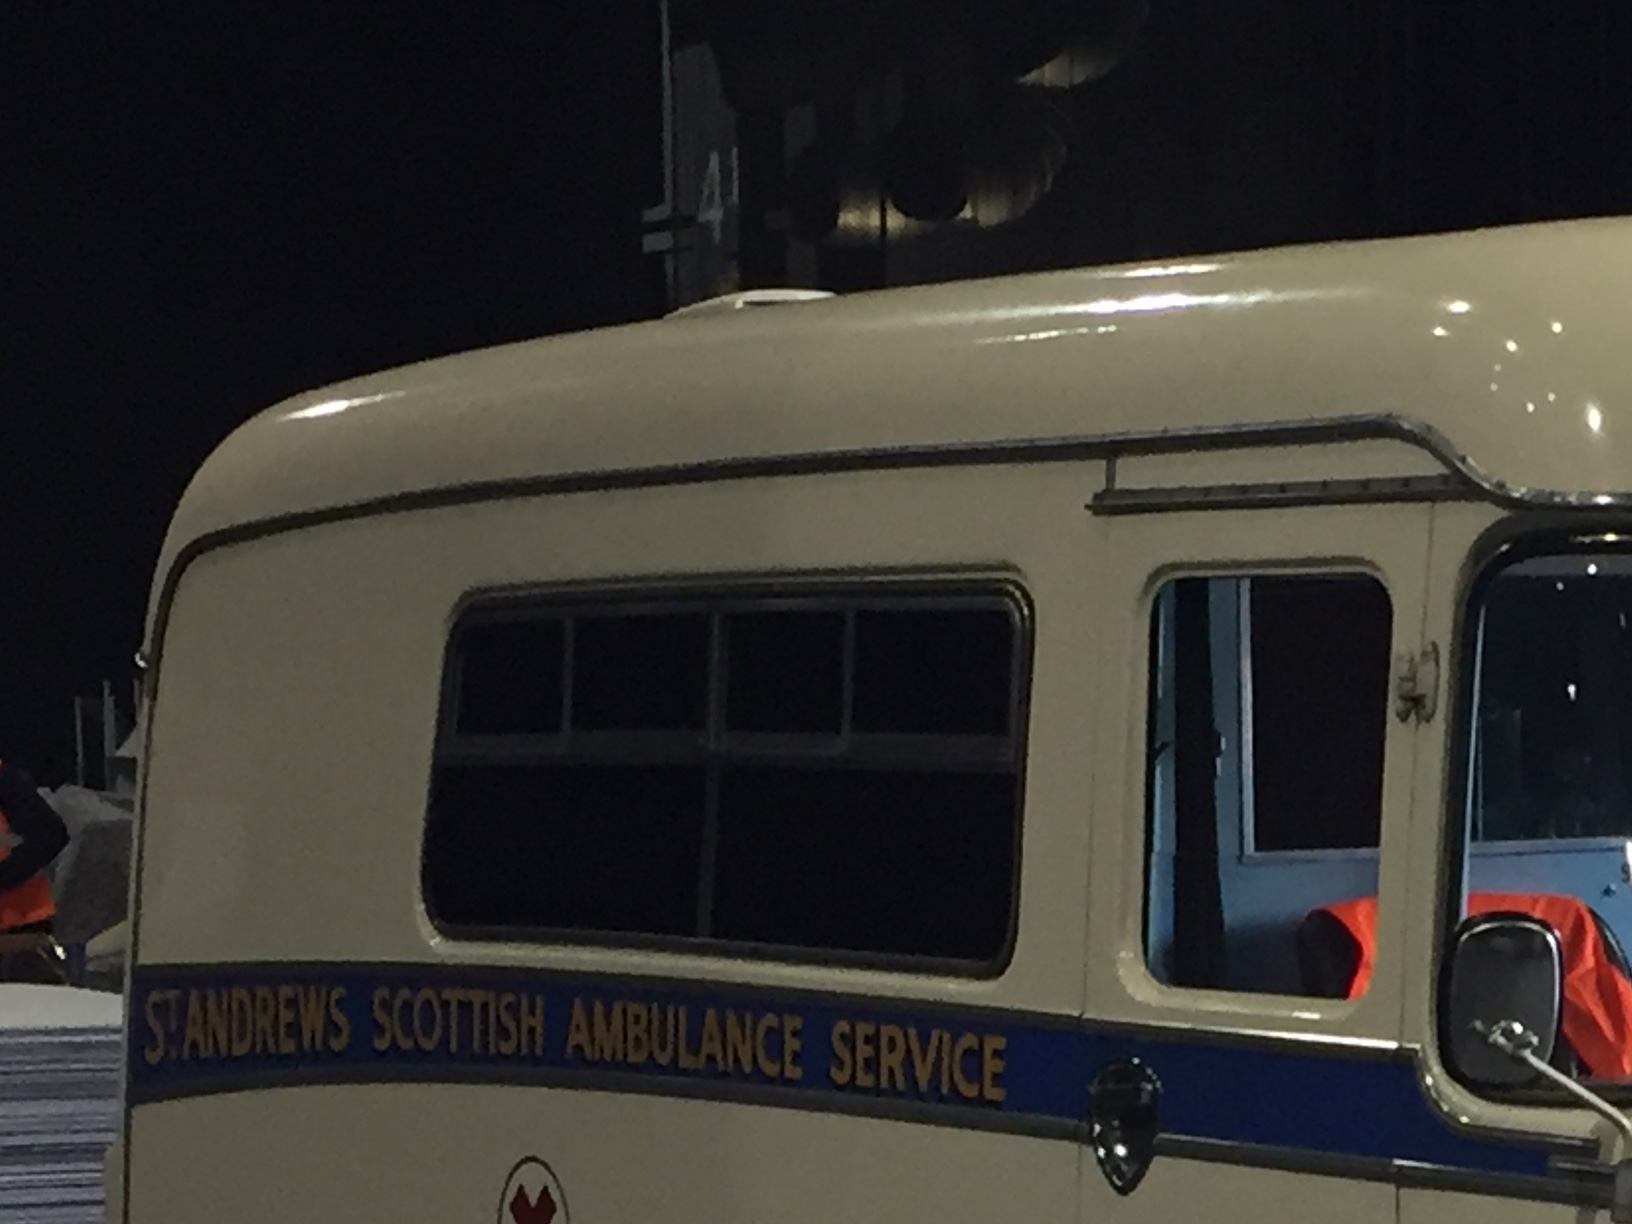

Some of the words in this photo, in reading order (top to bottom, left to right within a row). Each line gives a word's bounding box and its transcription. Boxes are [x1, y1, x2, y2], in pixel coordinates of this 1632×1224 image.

[182, 984, 350, 1060] ANDREWS
[372, 986, 544, 1057] SCOTTISH
[565, 997, 804, 1081] AMBULANCE
[829, 1018, 1008, 1101] SERVICE
